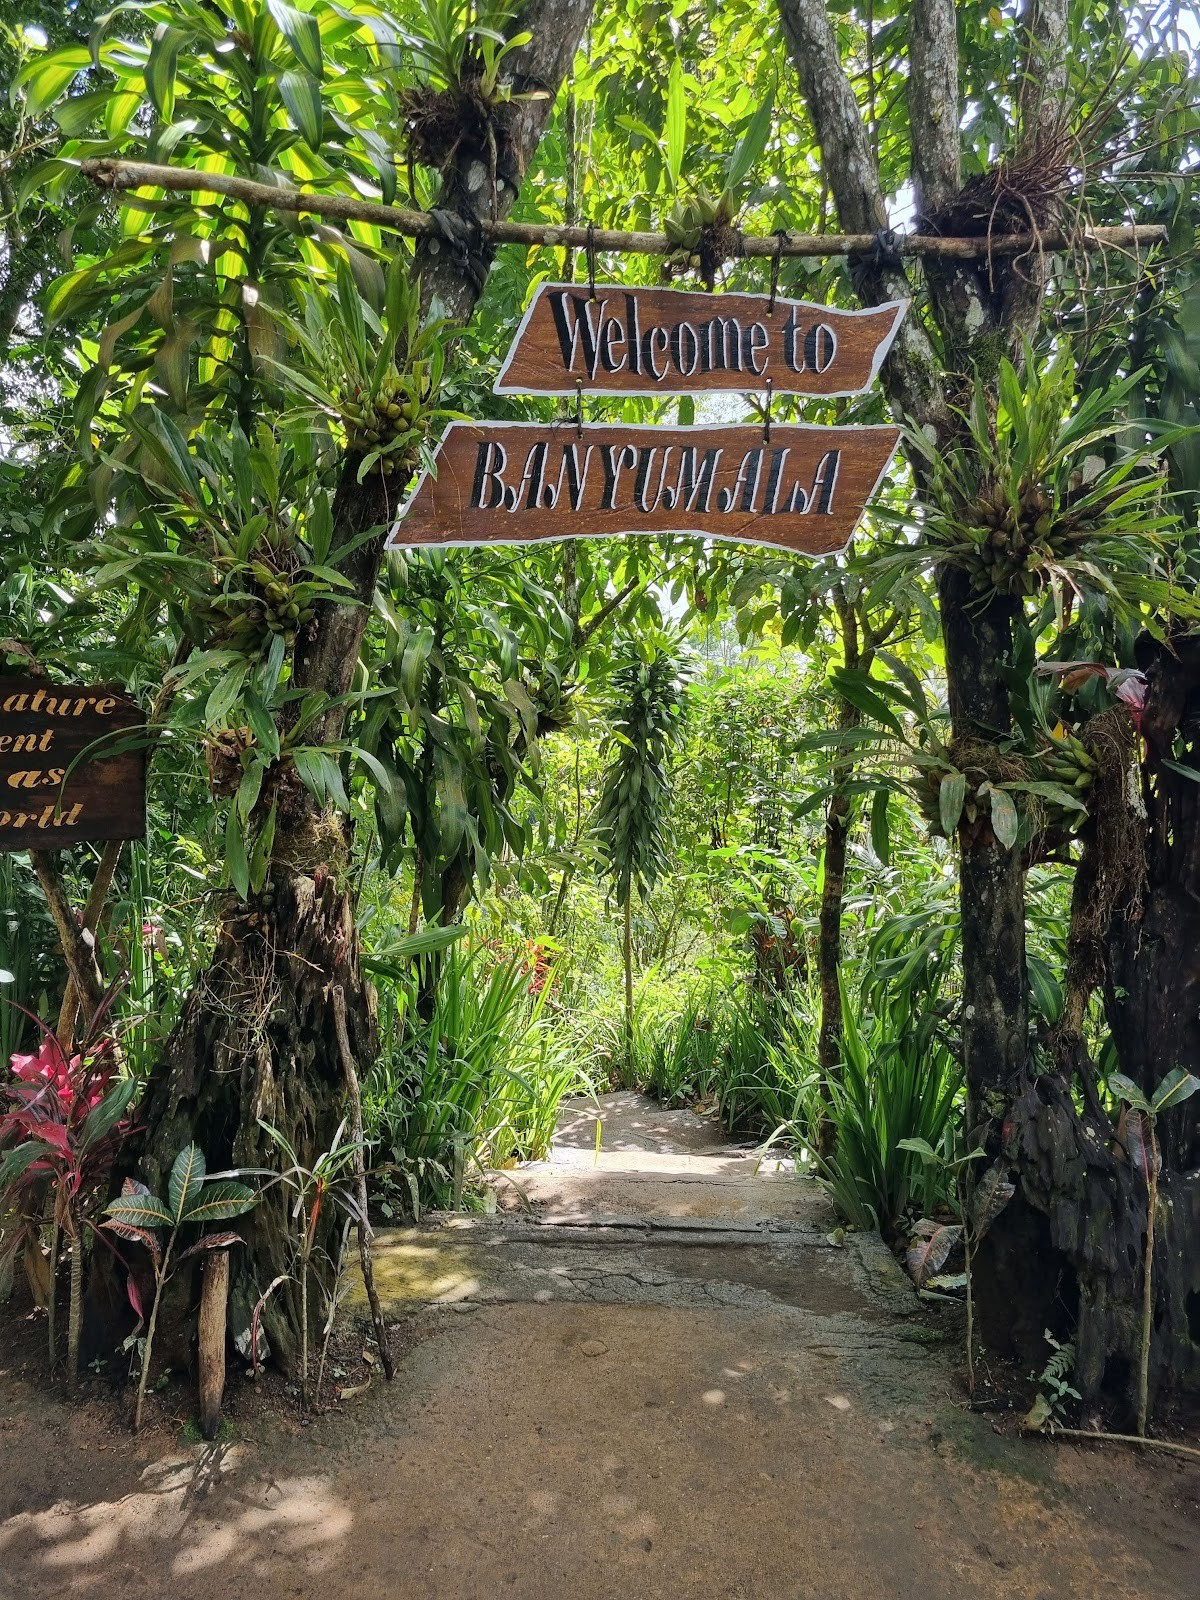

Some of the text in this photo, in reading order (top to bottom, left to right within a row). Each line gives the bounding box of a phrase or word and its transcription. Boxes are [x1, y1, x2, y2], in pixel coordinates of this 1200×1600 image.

[547, 291, 838, 381] Welcome to
[470, 441, 842, 515] BANYUMALA
[0, 689, 116, 716] ature
[7, 767, 66, 788] as
